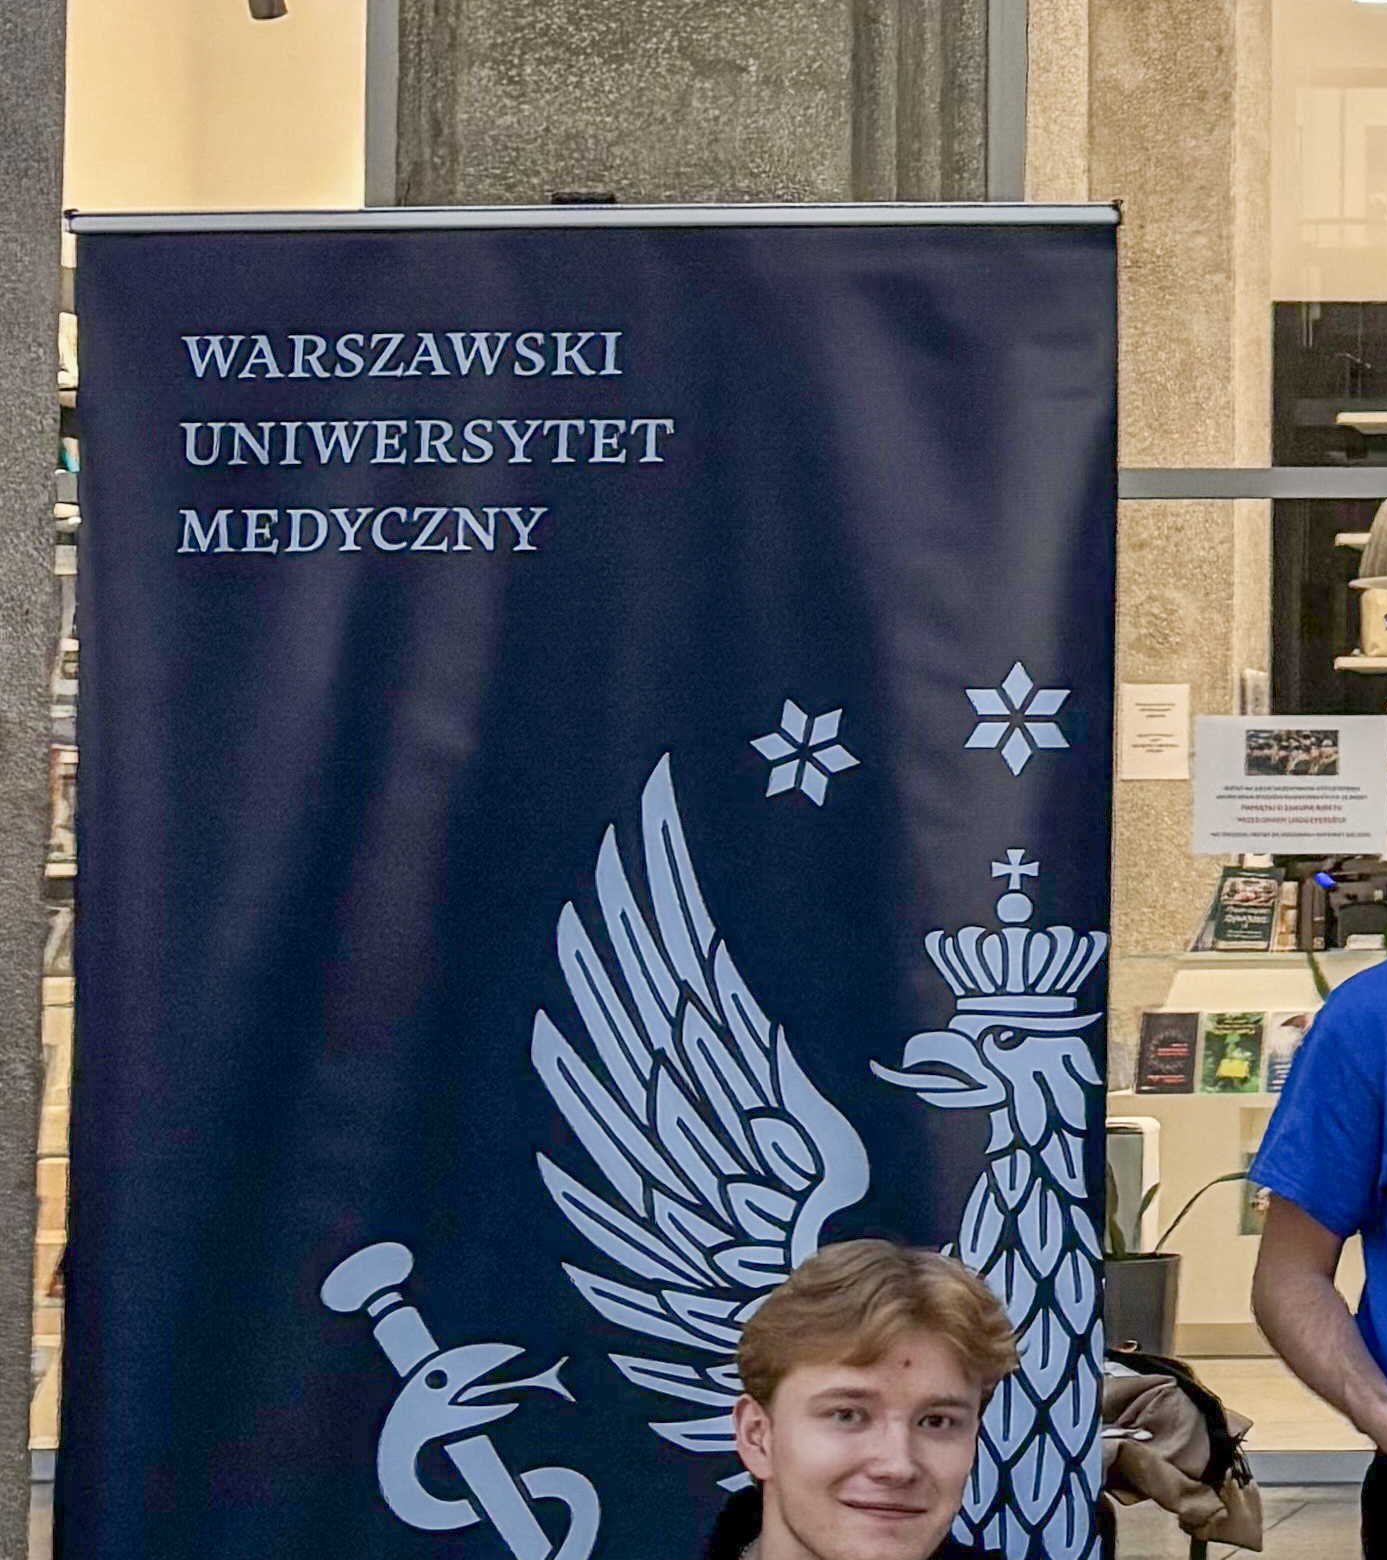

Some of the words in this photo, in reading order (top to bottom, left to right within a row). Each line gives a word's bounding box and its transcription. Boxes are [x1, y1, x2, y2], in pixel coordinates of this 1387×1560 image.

[182, 329, 623, 380] WARSZAWSKI
[180, 416, 676, 467] UNIWERSYTET
[177, 504, 549, 556] MEDYCZNY
